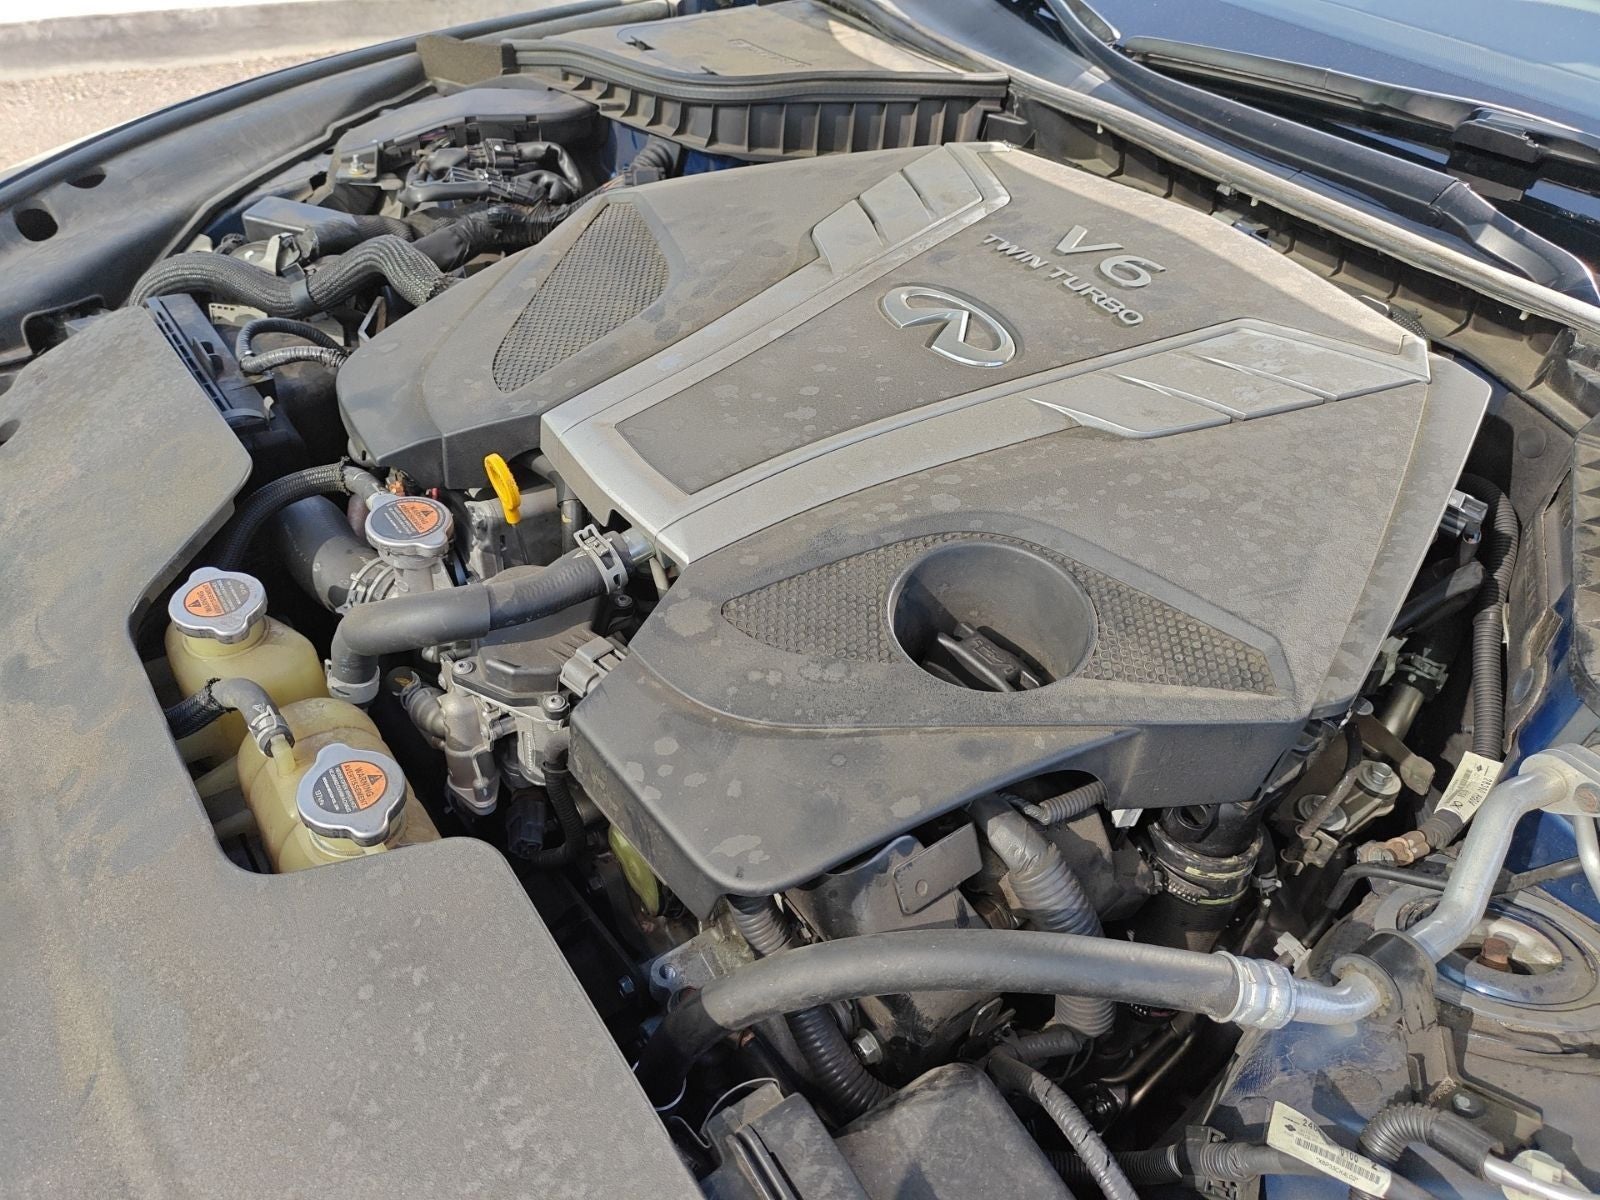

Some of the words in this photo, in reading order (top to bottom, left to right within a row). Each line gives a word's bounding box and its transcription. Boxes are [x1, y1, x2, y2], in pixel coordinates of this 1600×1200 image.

[983, 233, 1049, 270] TWIN
[1048, 266, 1144, 326] TURBO
[1056, 225, 1167, 288] V6
[344, 764, 368, 806] AVERTISSEMENT
[354, 767, 374, 798] WARNING
